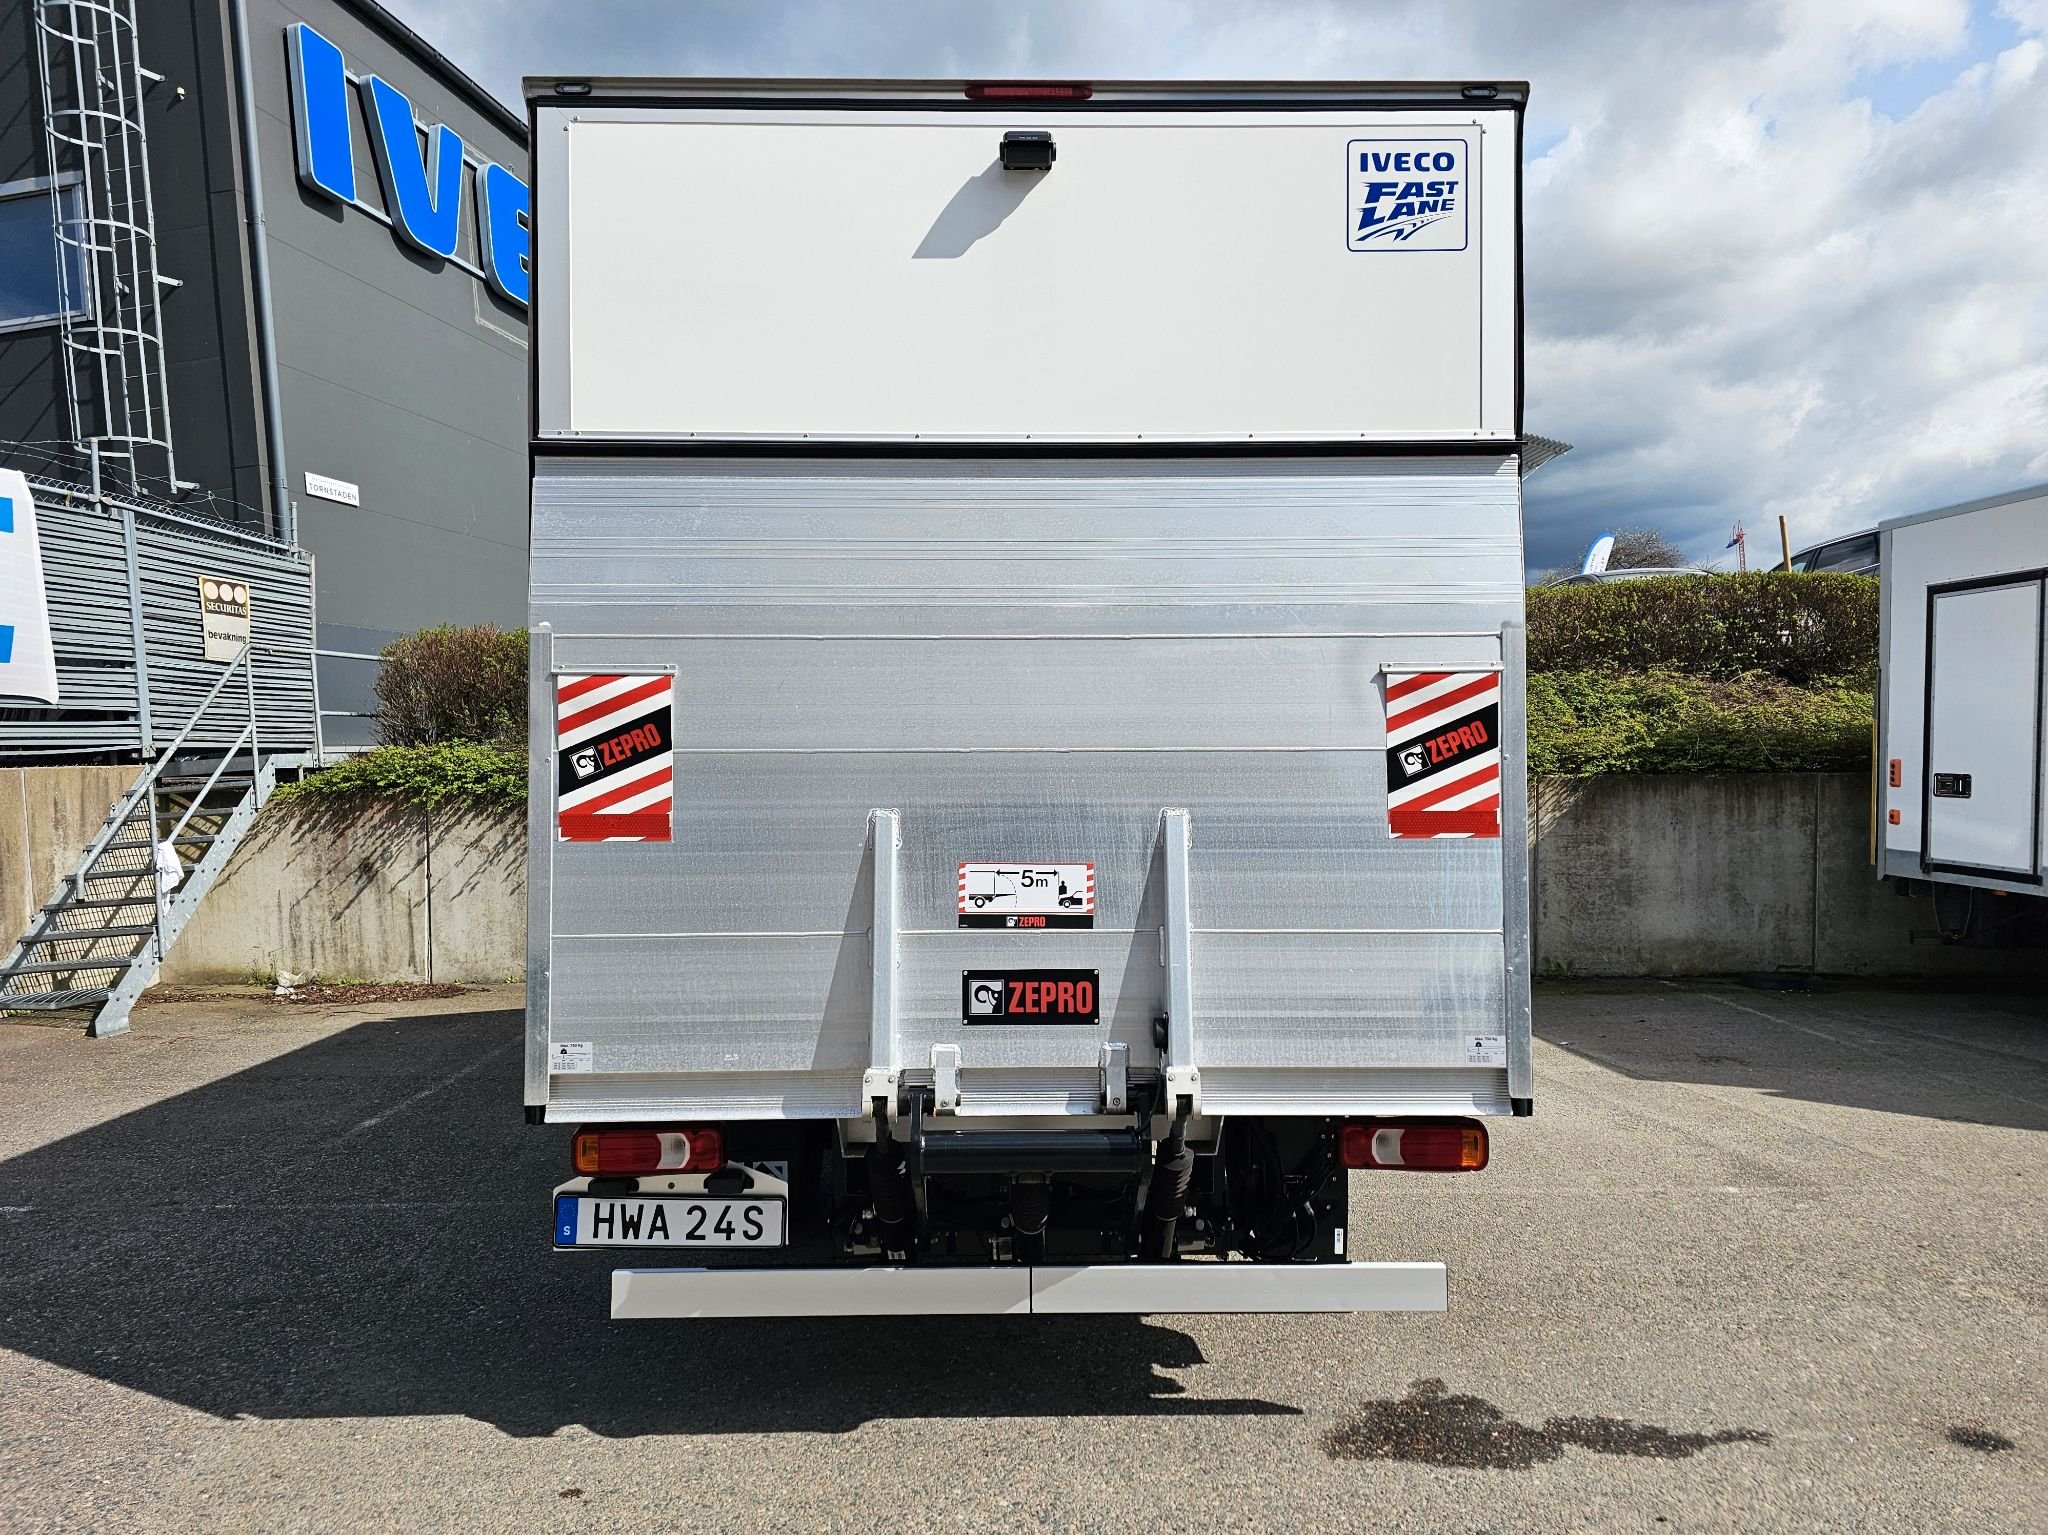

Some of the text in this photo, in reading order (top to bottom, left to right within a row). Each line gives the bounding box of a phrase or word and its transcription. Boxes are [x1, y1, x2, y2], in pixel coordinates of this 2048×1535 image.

[1360, 152, 1455, 172] IVECO
[1362, 181, 1459, 204] FAST
[1355, 199, 1456, 231] LANE
[308, 482, 357, 501] TORNSTADEN
[206, 601, 247, 616] SECURITAS
[208, 629, 247, 645] bevakning
[597, 723, 662, 767] ZEPRO
[1425, 720, 1489, 764] ZEPRO
[1019, 916, 1046, 927] ZEPRO
[1008, 981, 1093, 1014] ZEPRO
[563, 1202, 764, 1241] S HWA 24S
